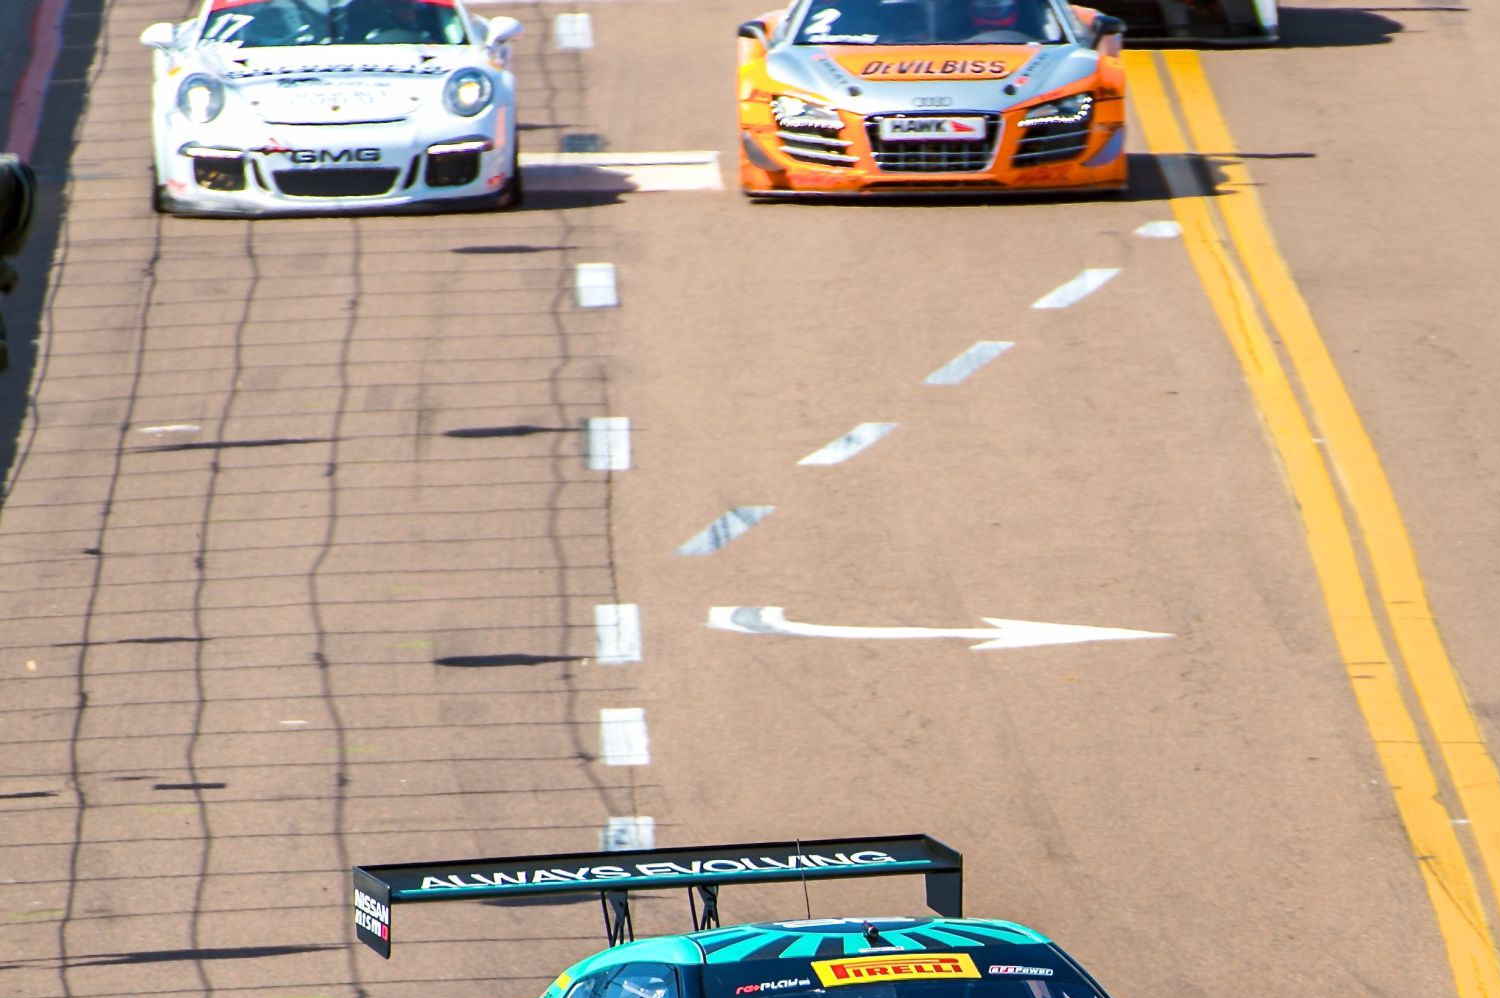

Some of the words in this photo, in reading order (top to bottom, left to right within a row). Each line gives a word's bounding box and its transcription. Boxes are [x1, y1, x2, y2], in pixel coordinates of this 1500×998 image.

[205, 13, 255, 43] 17
[805, 8, 841, 35] 2
[891, 119, 948, 133] HAWK
[291, 147, 381, 164] GMG
[420, 865, 632, 890] ALWAYS
[635, 851, 898, 878] EVOLVING
[354, 887, 390, 925] NISSAN
[830, 957, 964, 980] PIRELLI
